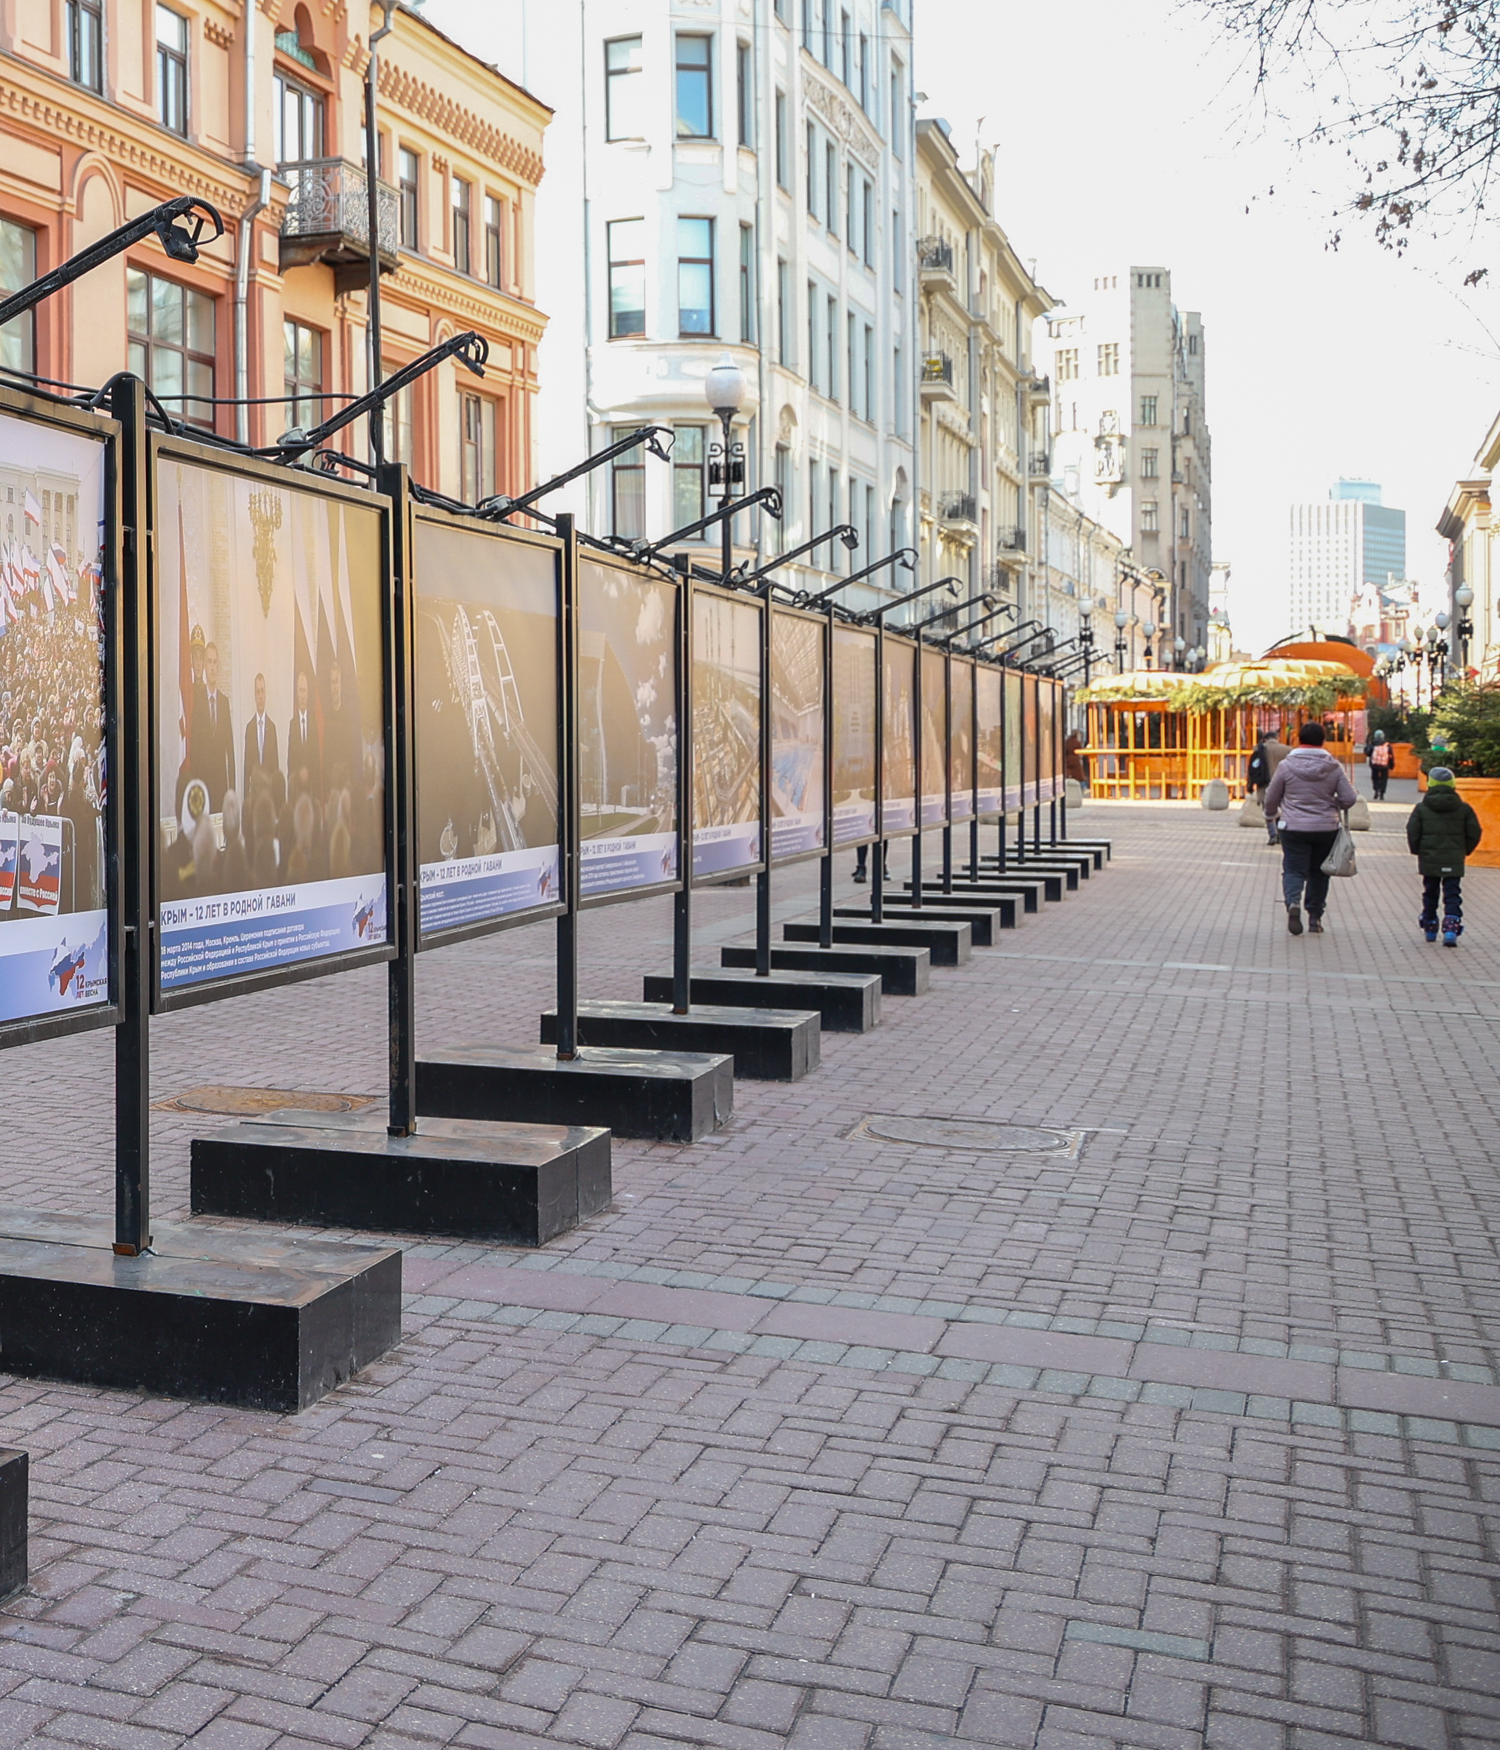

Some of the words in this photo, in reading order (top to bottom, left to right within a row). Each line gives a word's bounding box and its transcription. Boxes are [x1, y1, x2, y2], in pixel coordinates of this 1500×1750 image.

[160, 908, 187, 926] КРЫМ
[195, 906, 204, 921] 12
[205, 903, 220, 919] ЛЕТ
[223, 902, 228, 916] В
[230, 894, 263, 916] РОДНОЙ
[266, 892, 296, 910] ГАВАНИ
[76, 974, 84, 989] 12
